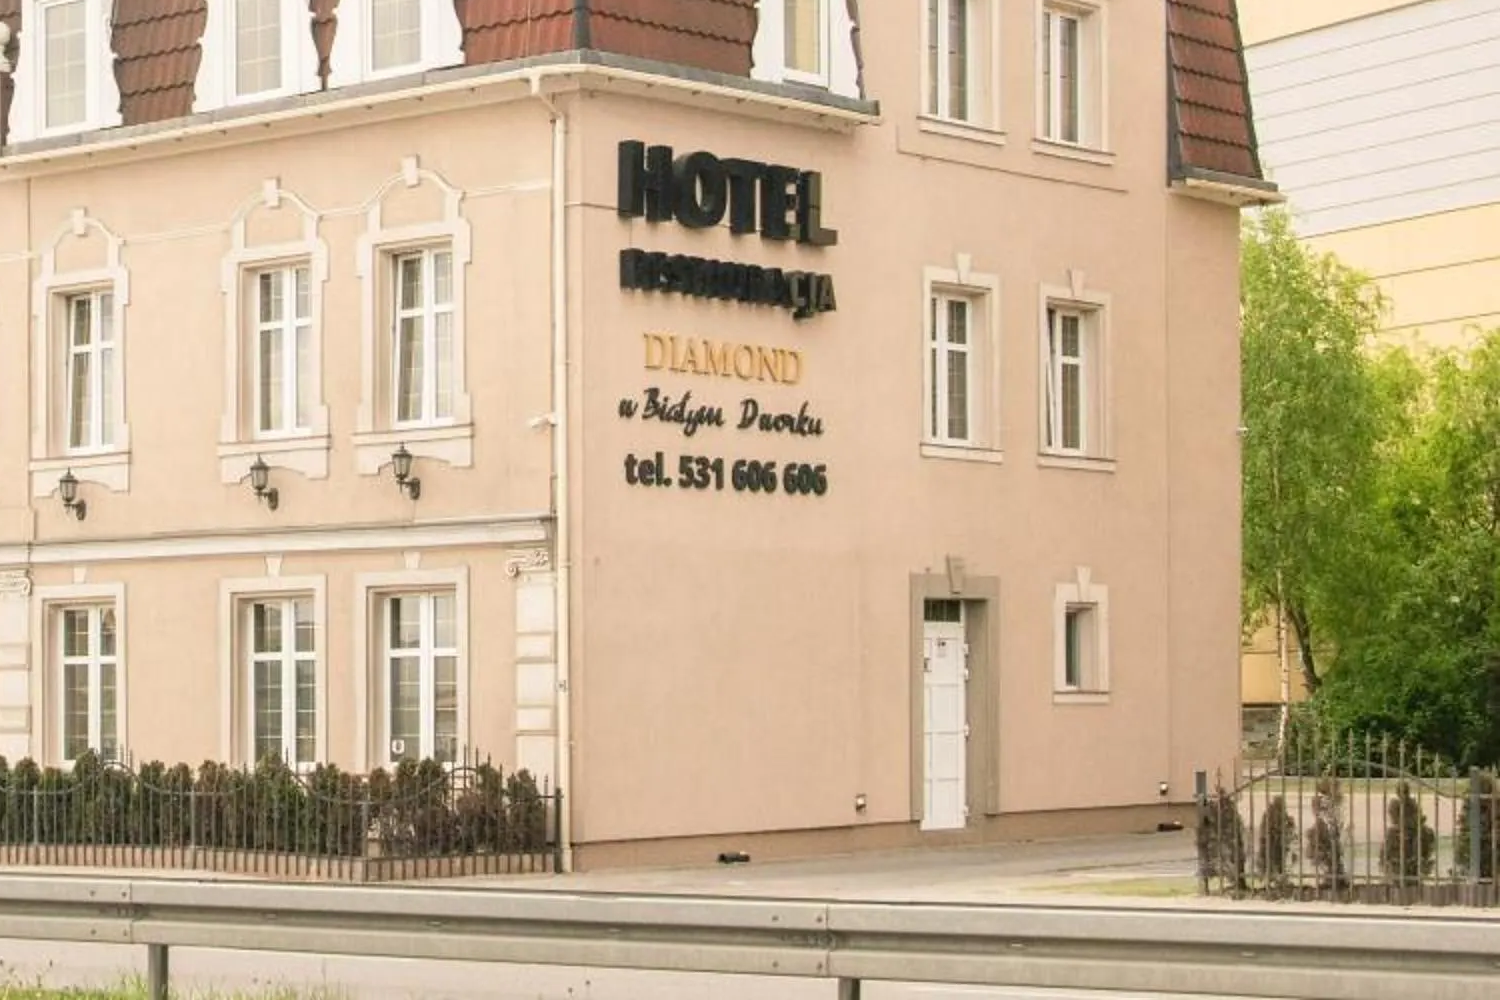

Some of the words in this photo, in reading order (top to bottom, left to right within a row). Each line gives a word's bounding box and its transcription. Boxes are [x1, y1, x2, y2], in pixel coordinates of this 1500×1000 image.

[617, 139, 838, 246] HOTEL
[642, 333, 804, 385] DIAMOND
[618, 398, 639, 419] w
[737, 398, 824, 437] Dworku
[624, 451, 673, 486] tel.
[678, 455, 725, 491] 531
[731, 459, 778, 494] 606
[782, 462, 828, 497] 606
